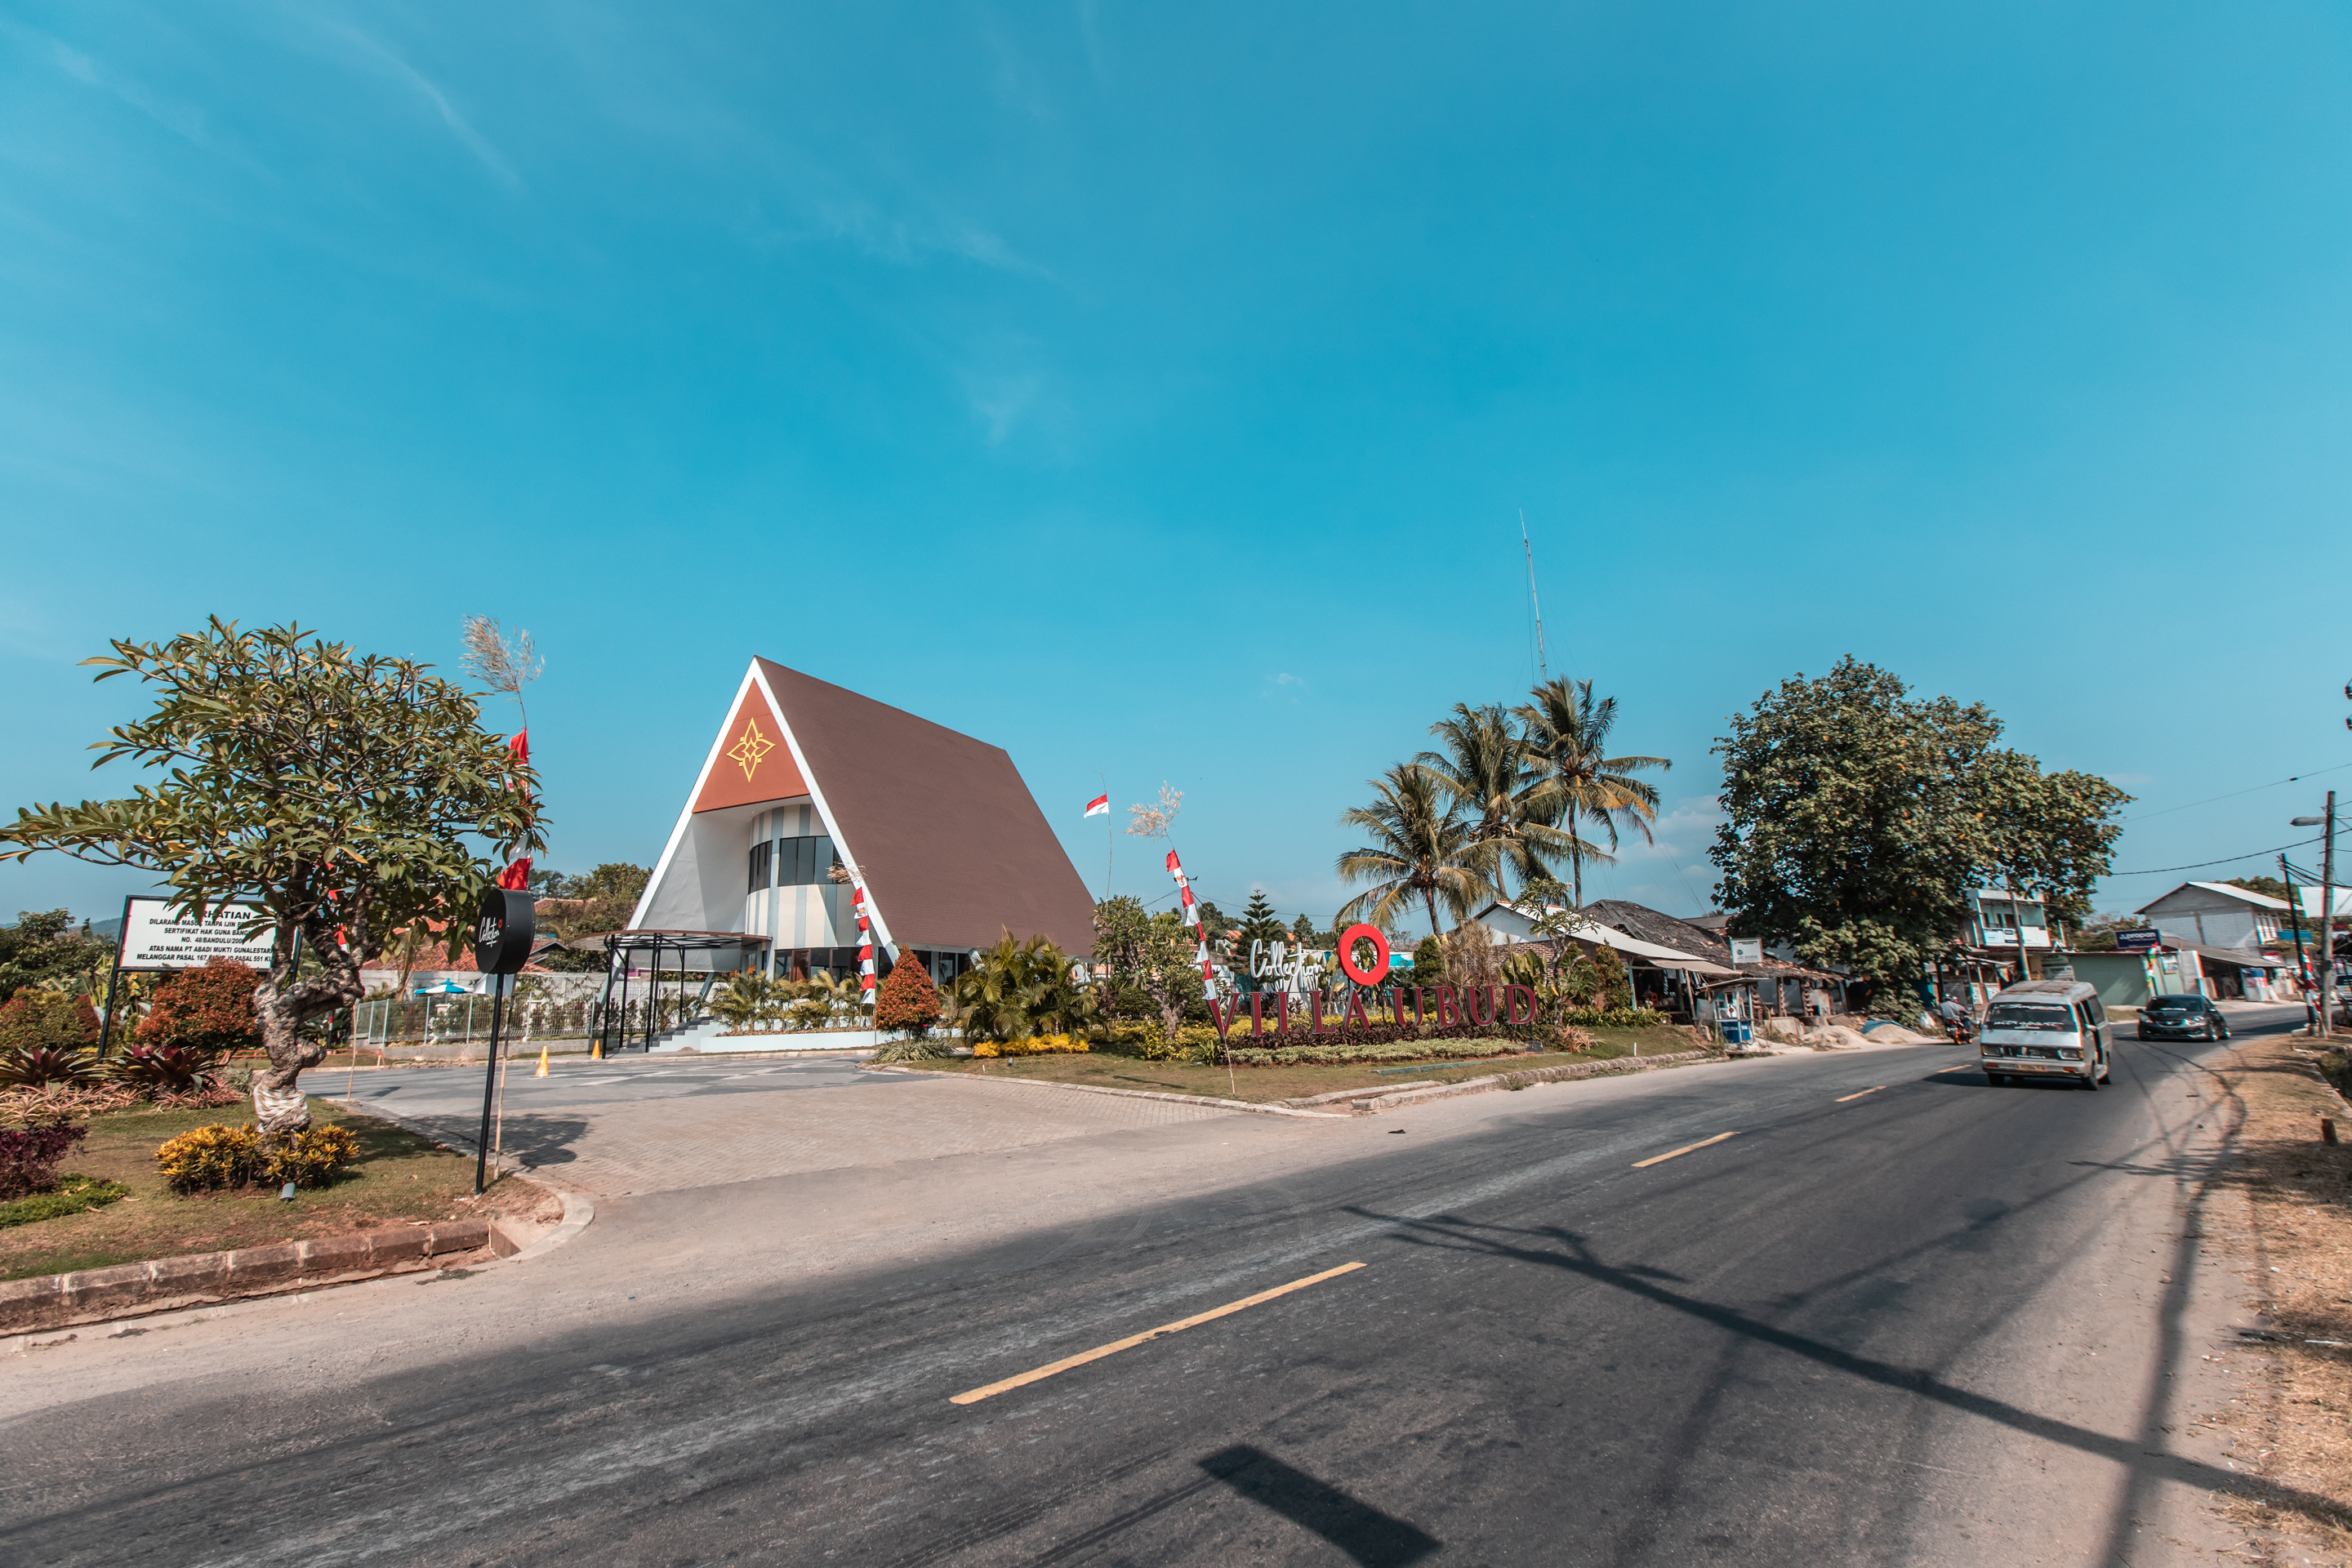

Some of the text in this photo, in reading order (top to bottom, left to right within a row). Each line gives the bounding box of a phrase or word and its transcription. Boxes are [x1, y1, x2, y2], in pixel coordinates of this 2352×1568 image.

[185, 911, 251, 920] PRHATIAN
[479, 916, 501, 947] Collection
[1250, 938, 1325, 988] Collection
[1203, 983, 1537, 1040] VILLA UBUD
